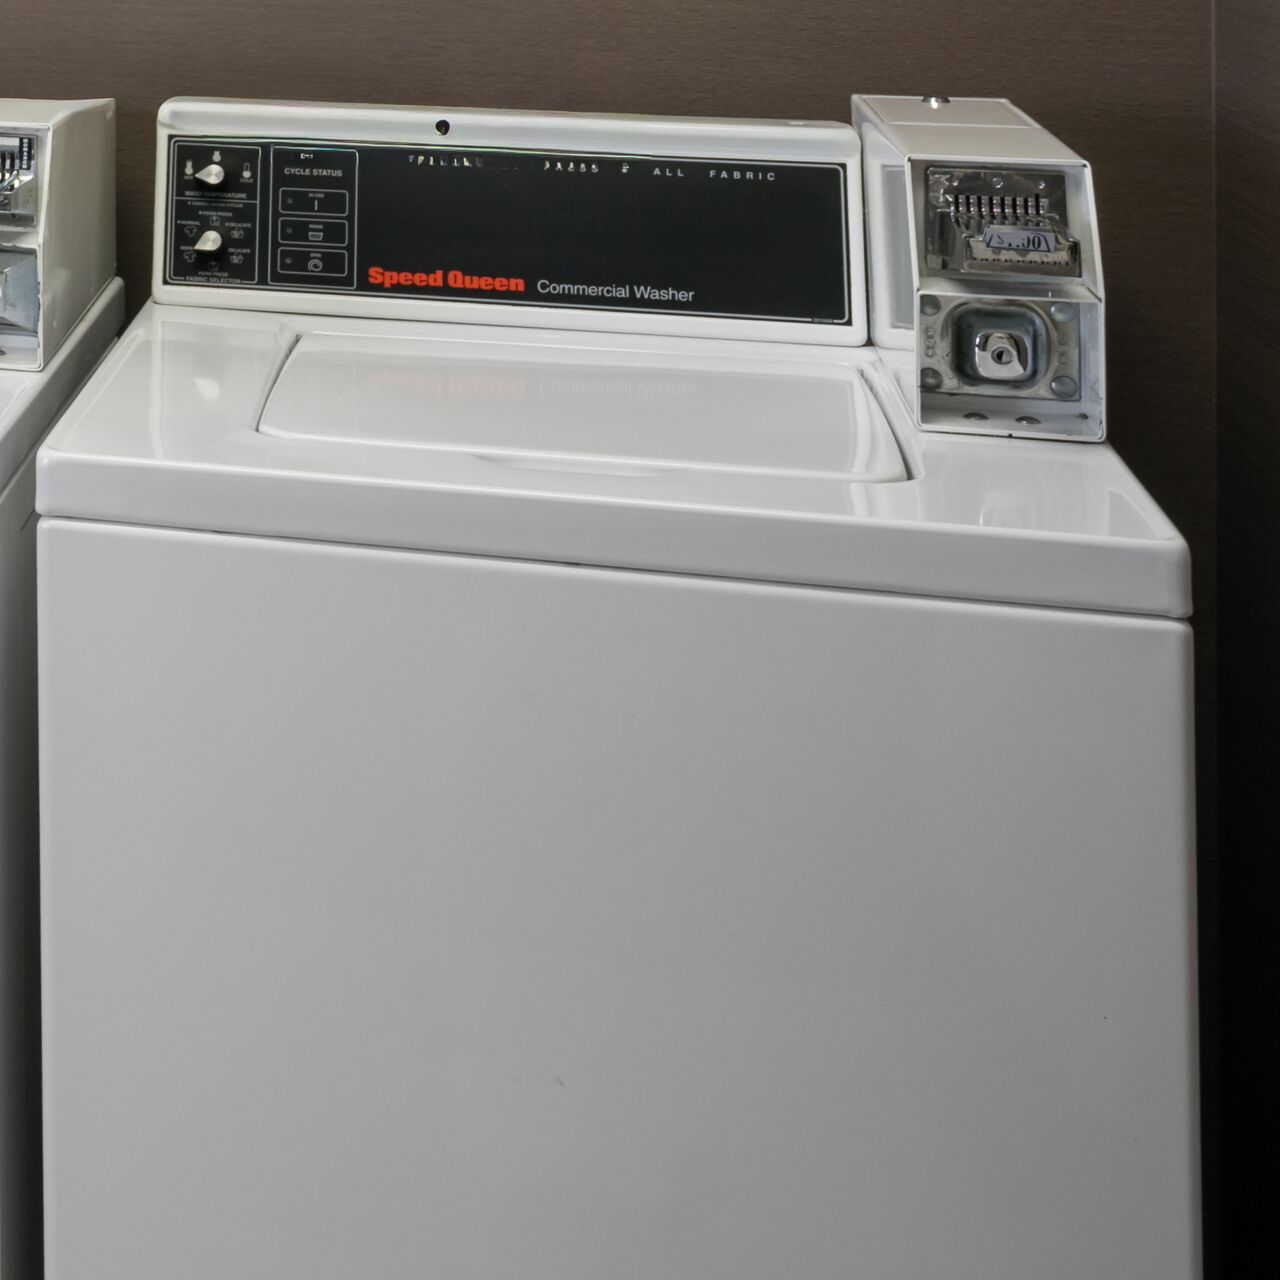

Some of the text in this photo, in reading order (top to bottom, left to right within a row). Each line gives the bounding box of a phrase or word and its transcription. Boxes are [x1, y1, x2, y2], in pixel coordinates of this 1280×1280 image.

[284, 167, 343, 177] CYCLE STATUS
[653, 167, 685, 177] ALL
[709, 169, 775, 181] FABRIC
[368, 266, 695, 302] Speed Queen Commercial Washer
